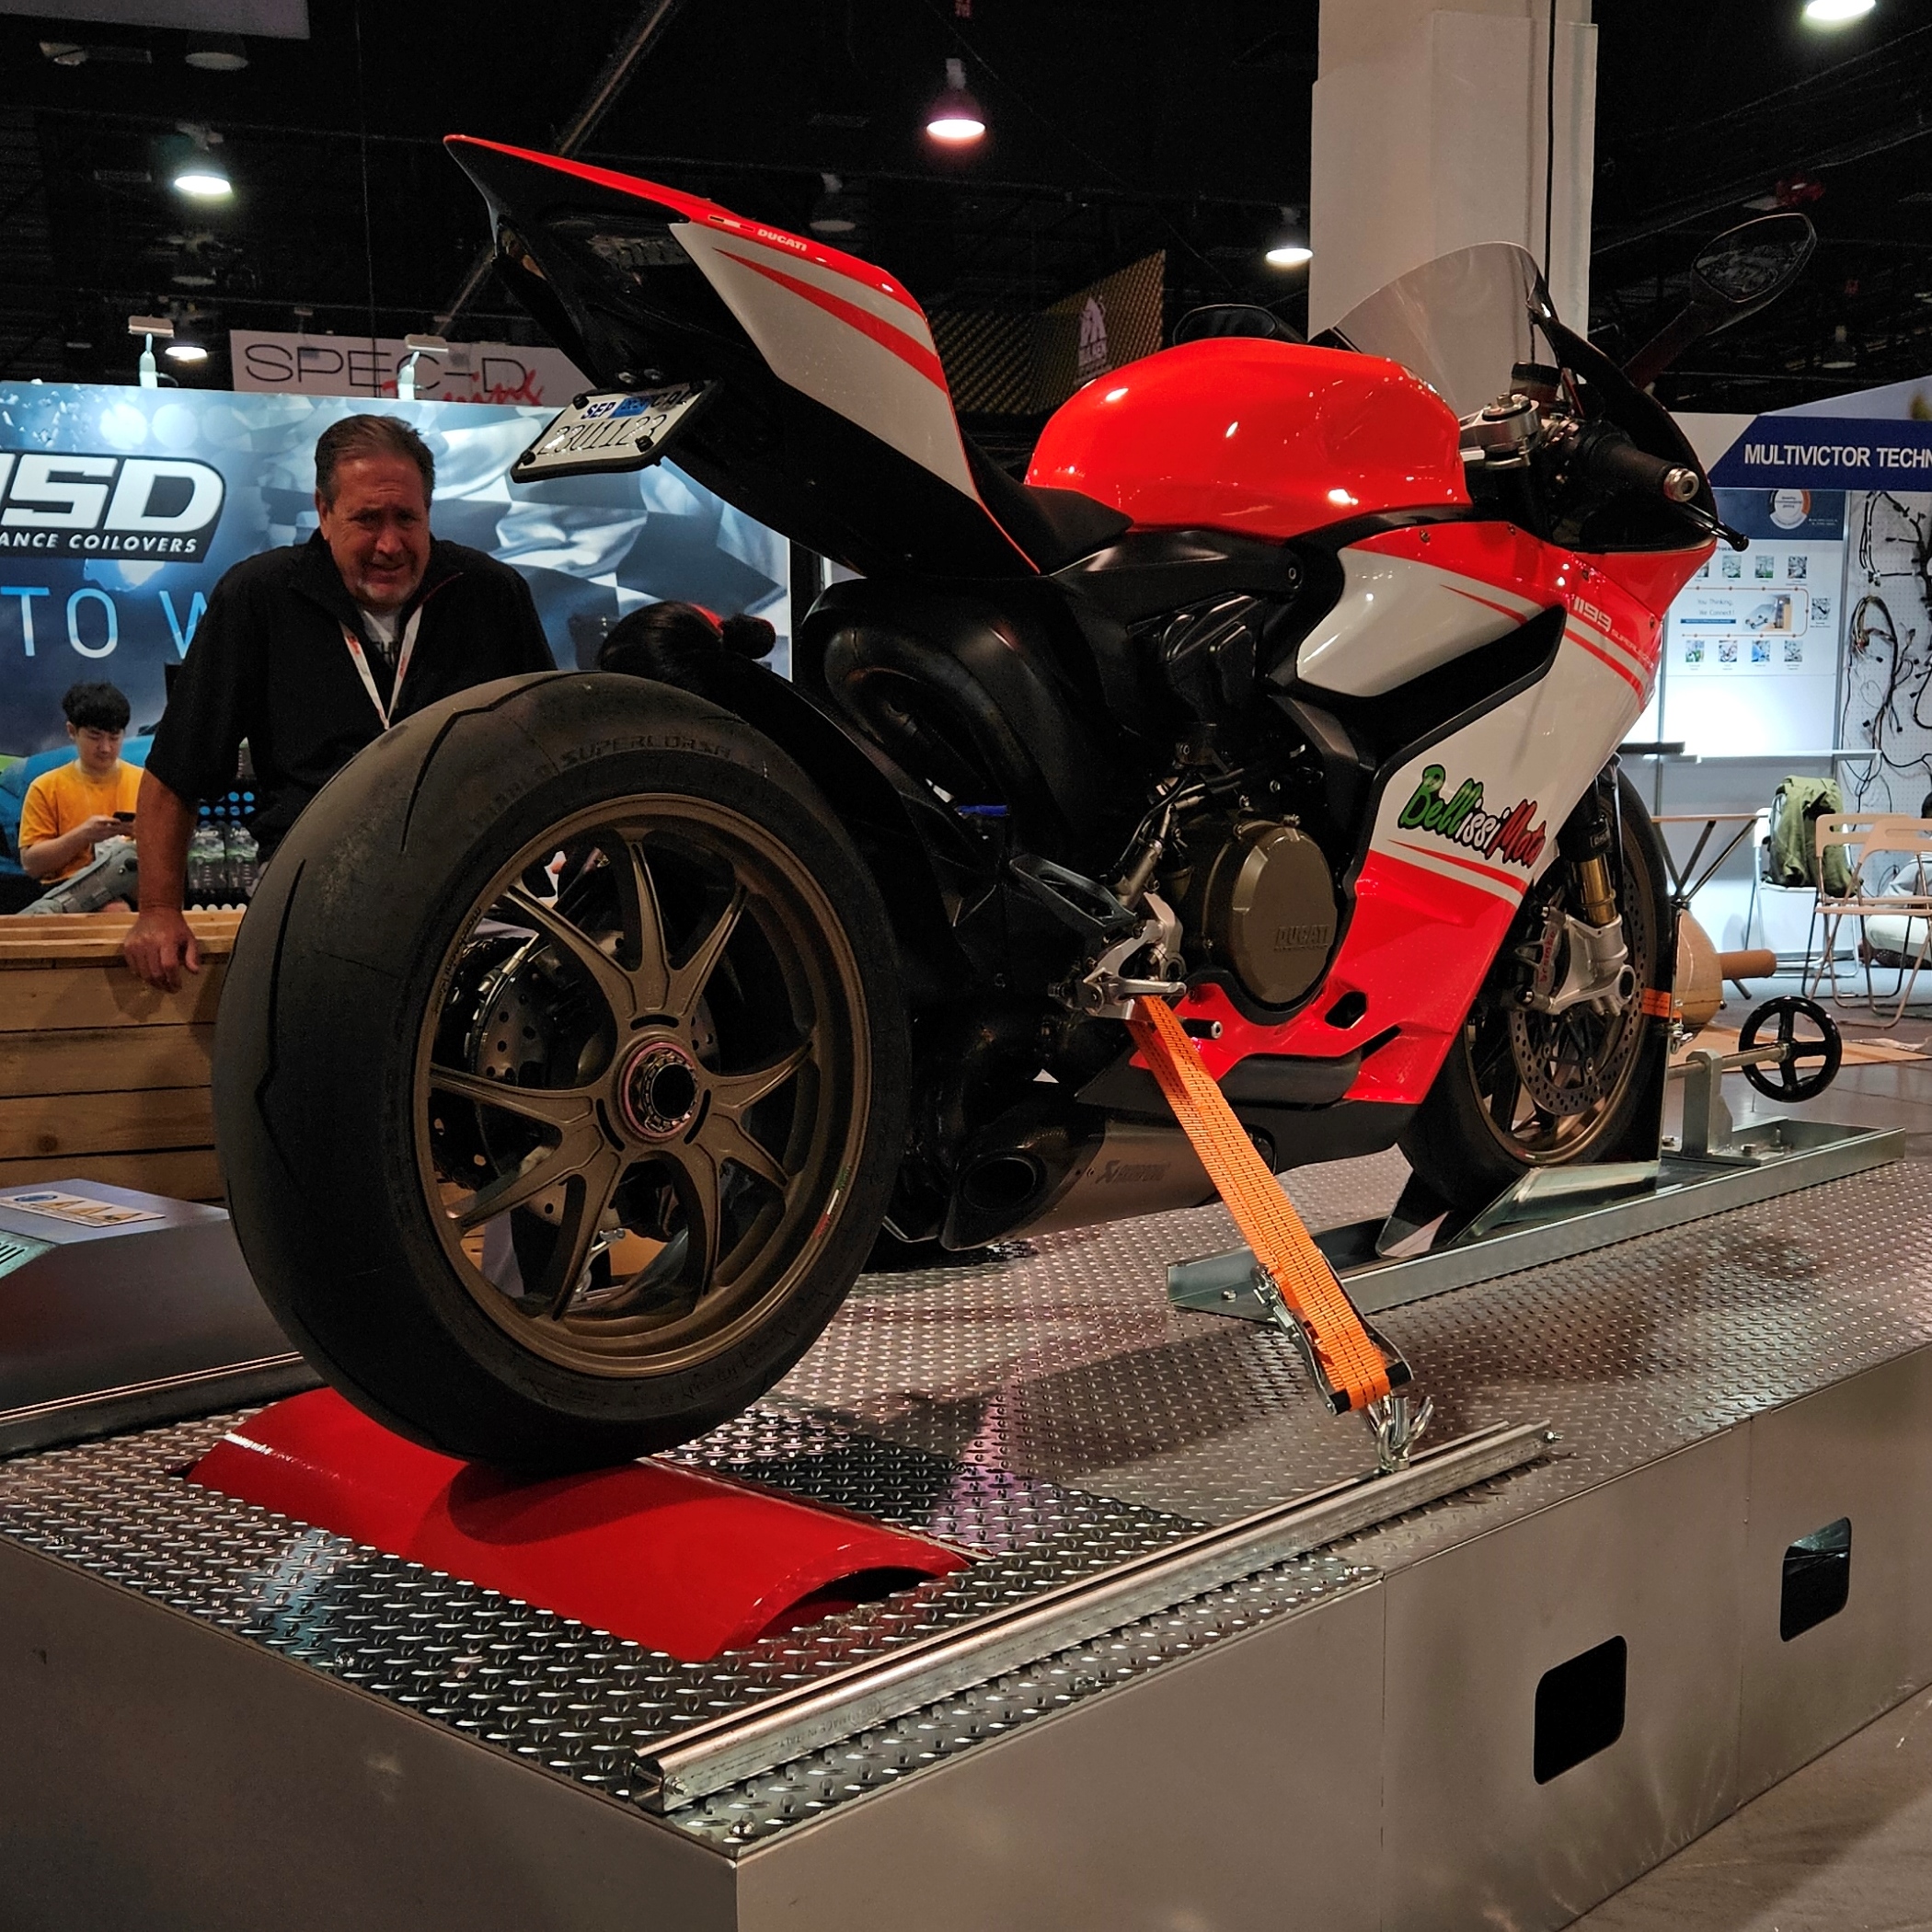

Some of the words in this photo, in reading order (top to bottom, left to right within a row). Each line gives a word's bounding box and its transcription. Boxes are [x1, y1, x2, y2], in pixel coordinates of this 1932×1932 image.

[757, 228, 808, 252] DUCATI
[581, 401, 617, 420] SEP
[1744, 444, 1870, 466] MULTIVICTOR
[0, 452, 224, 533] SD
[69, 534, 197, 553] COILOVERS
[0, 586, 119, 659] TO
[1574, 596, 1612, 633] 1199
[1275, 924, 1328, 949] DUCATI
[1539, 930, 1557, 983] brembo
